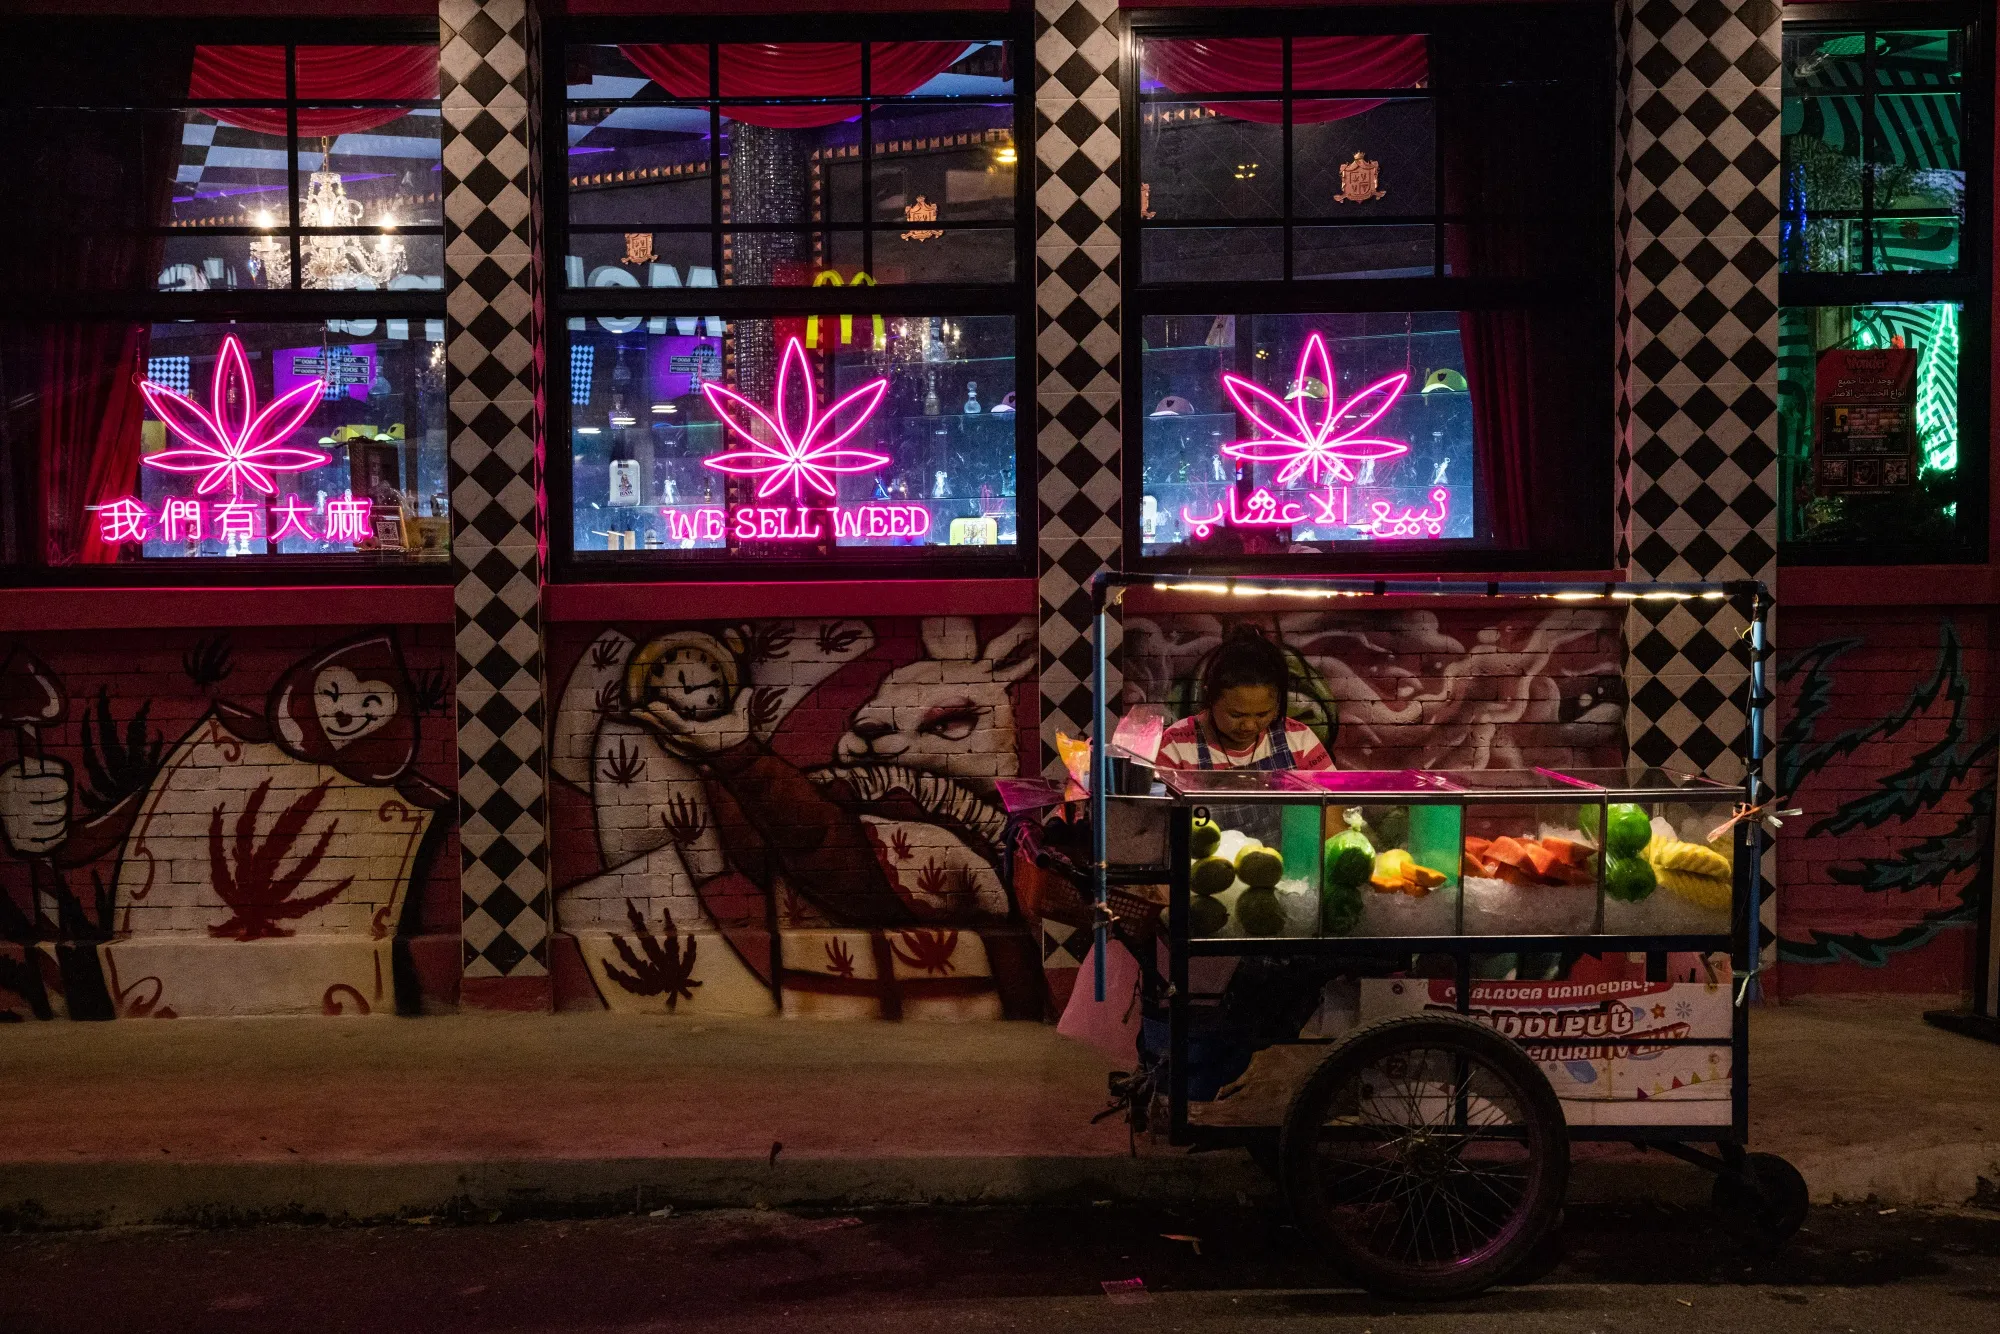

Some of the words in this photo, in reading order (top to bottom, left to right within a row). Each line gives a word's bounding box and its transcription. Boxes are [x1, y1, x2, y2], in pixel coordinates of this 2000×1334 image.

[100, 494, 371, 542] 我們有大麻
[662, 508, 726, 540] WE
[735, 507, 820, 539] SELL
[826, 505, 931, 538] WEED
[1371, 488, 1448, 538] نبيع
[1193, 805, 1211, 827] 9
